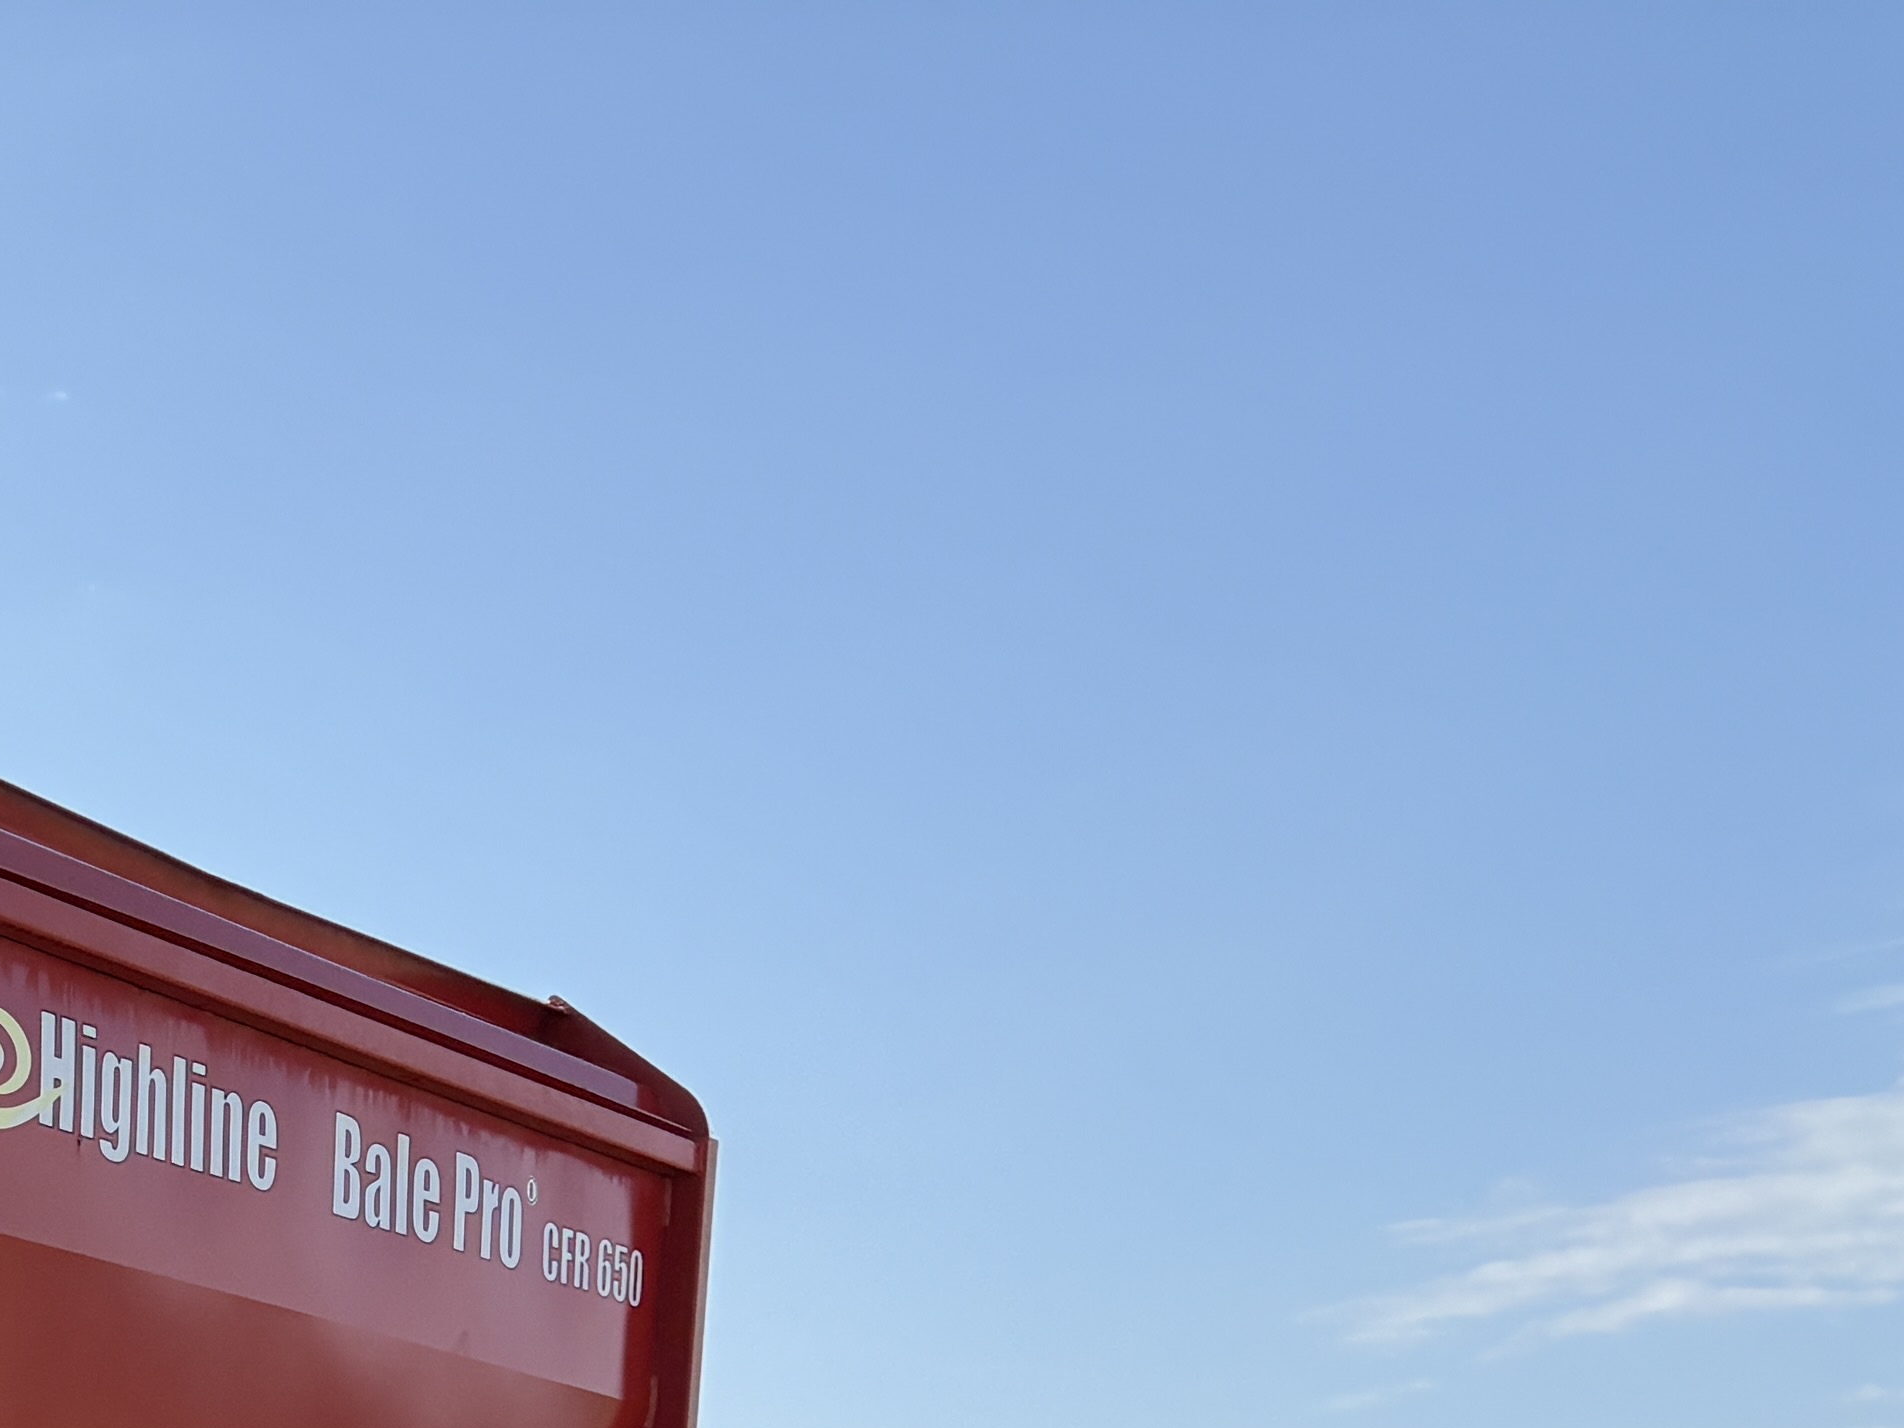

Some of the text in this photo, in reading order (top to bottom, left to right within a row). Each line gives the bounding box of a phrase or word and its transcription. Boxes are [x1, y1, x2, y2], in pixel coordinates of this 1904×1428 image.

[39, 1009, 278, 1191] Highline
[332, 1111, 441, 1243] Bale
[542, 1222, 591, 1292] CFR
[596, 1238, 643, 1308] 650
